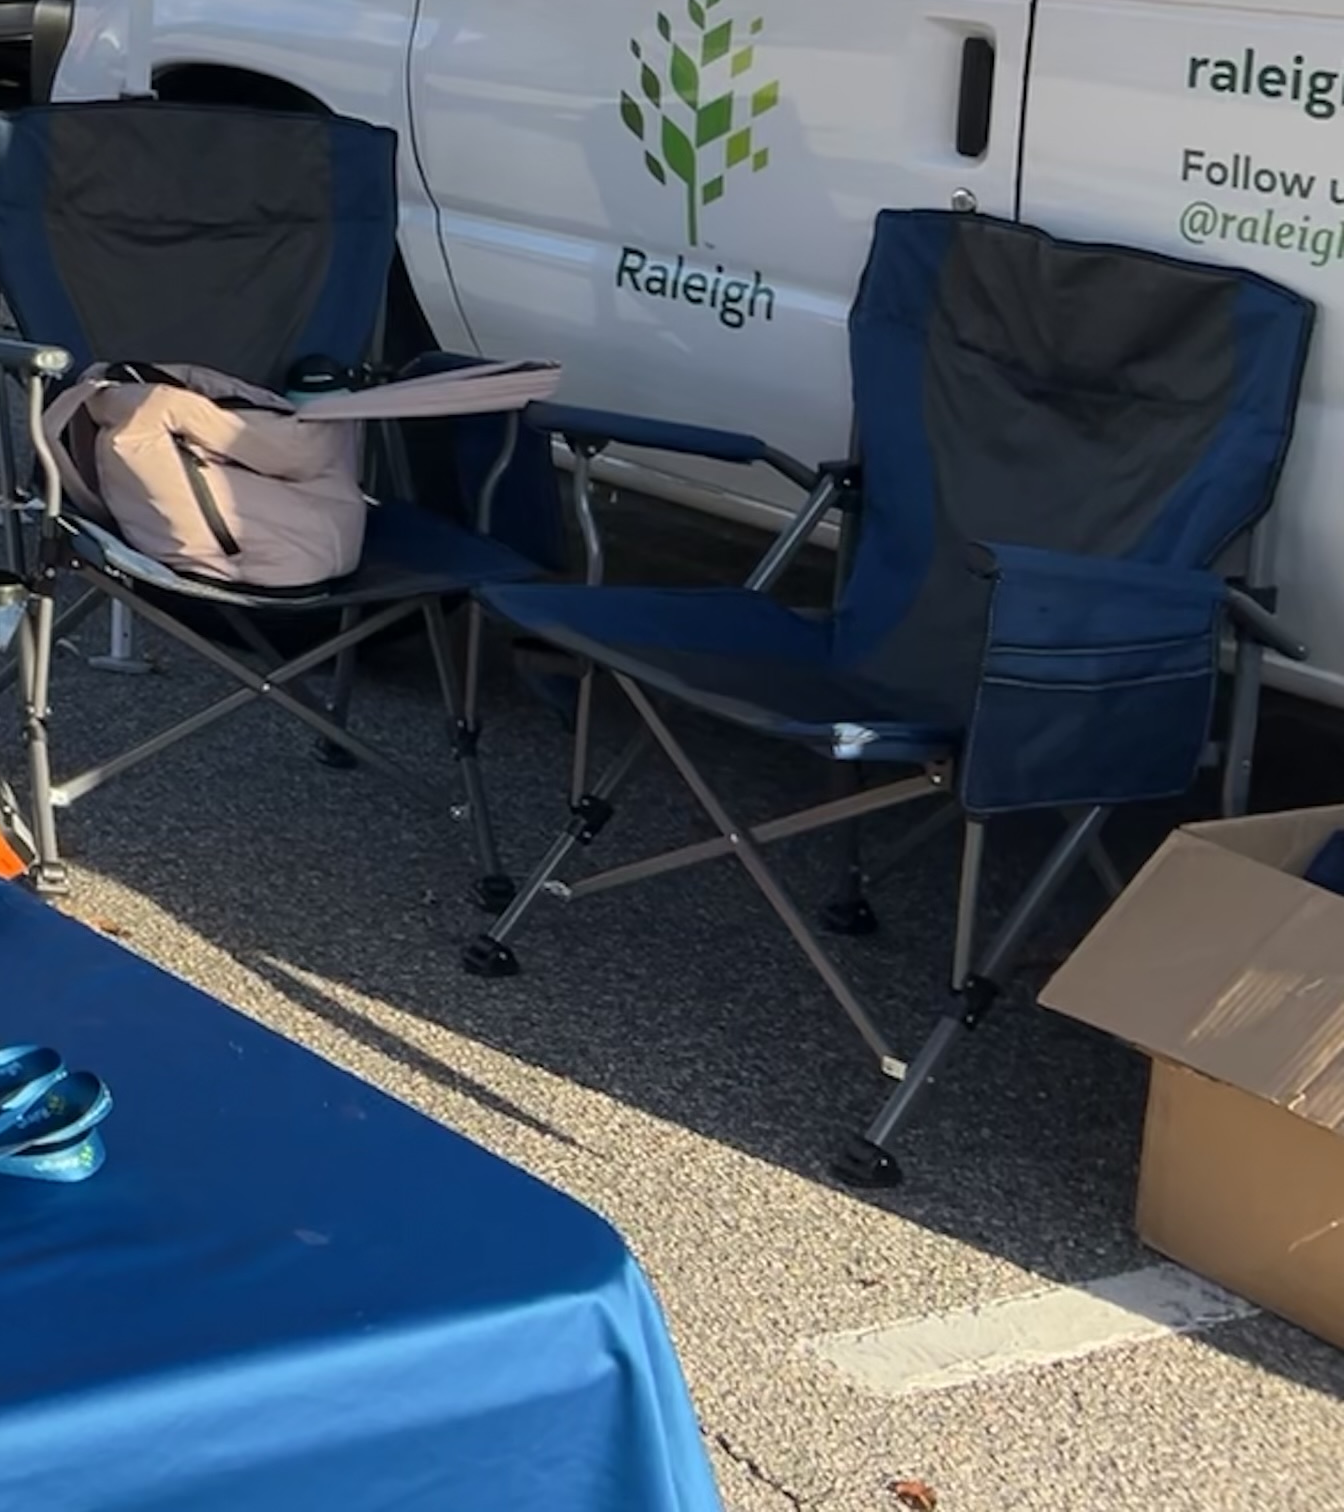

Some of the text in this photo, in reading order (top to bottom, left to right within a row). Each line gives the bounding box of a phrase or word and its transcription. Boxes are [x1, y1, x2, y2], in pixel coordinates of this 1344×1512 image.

[1187, 47, 1344, 120] raleig
[1181, 148, 1316, 200] Follow
[1179, 200, 1344, 267] @raleig
[617, 247, 776, 329] Raleigh
